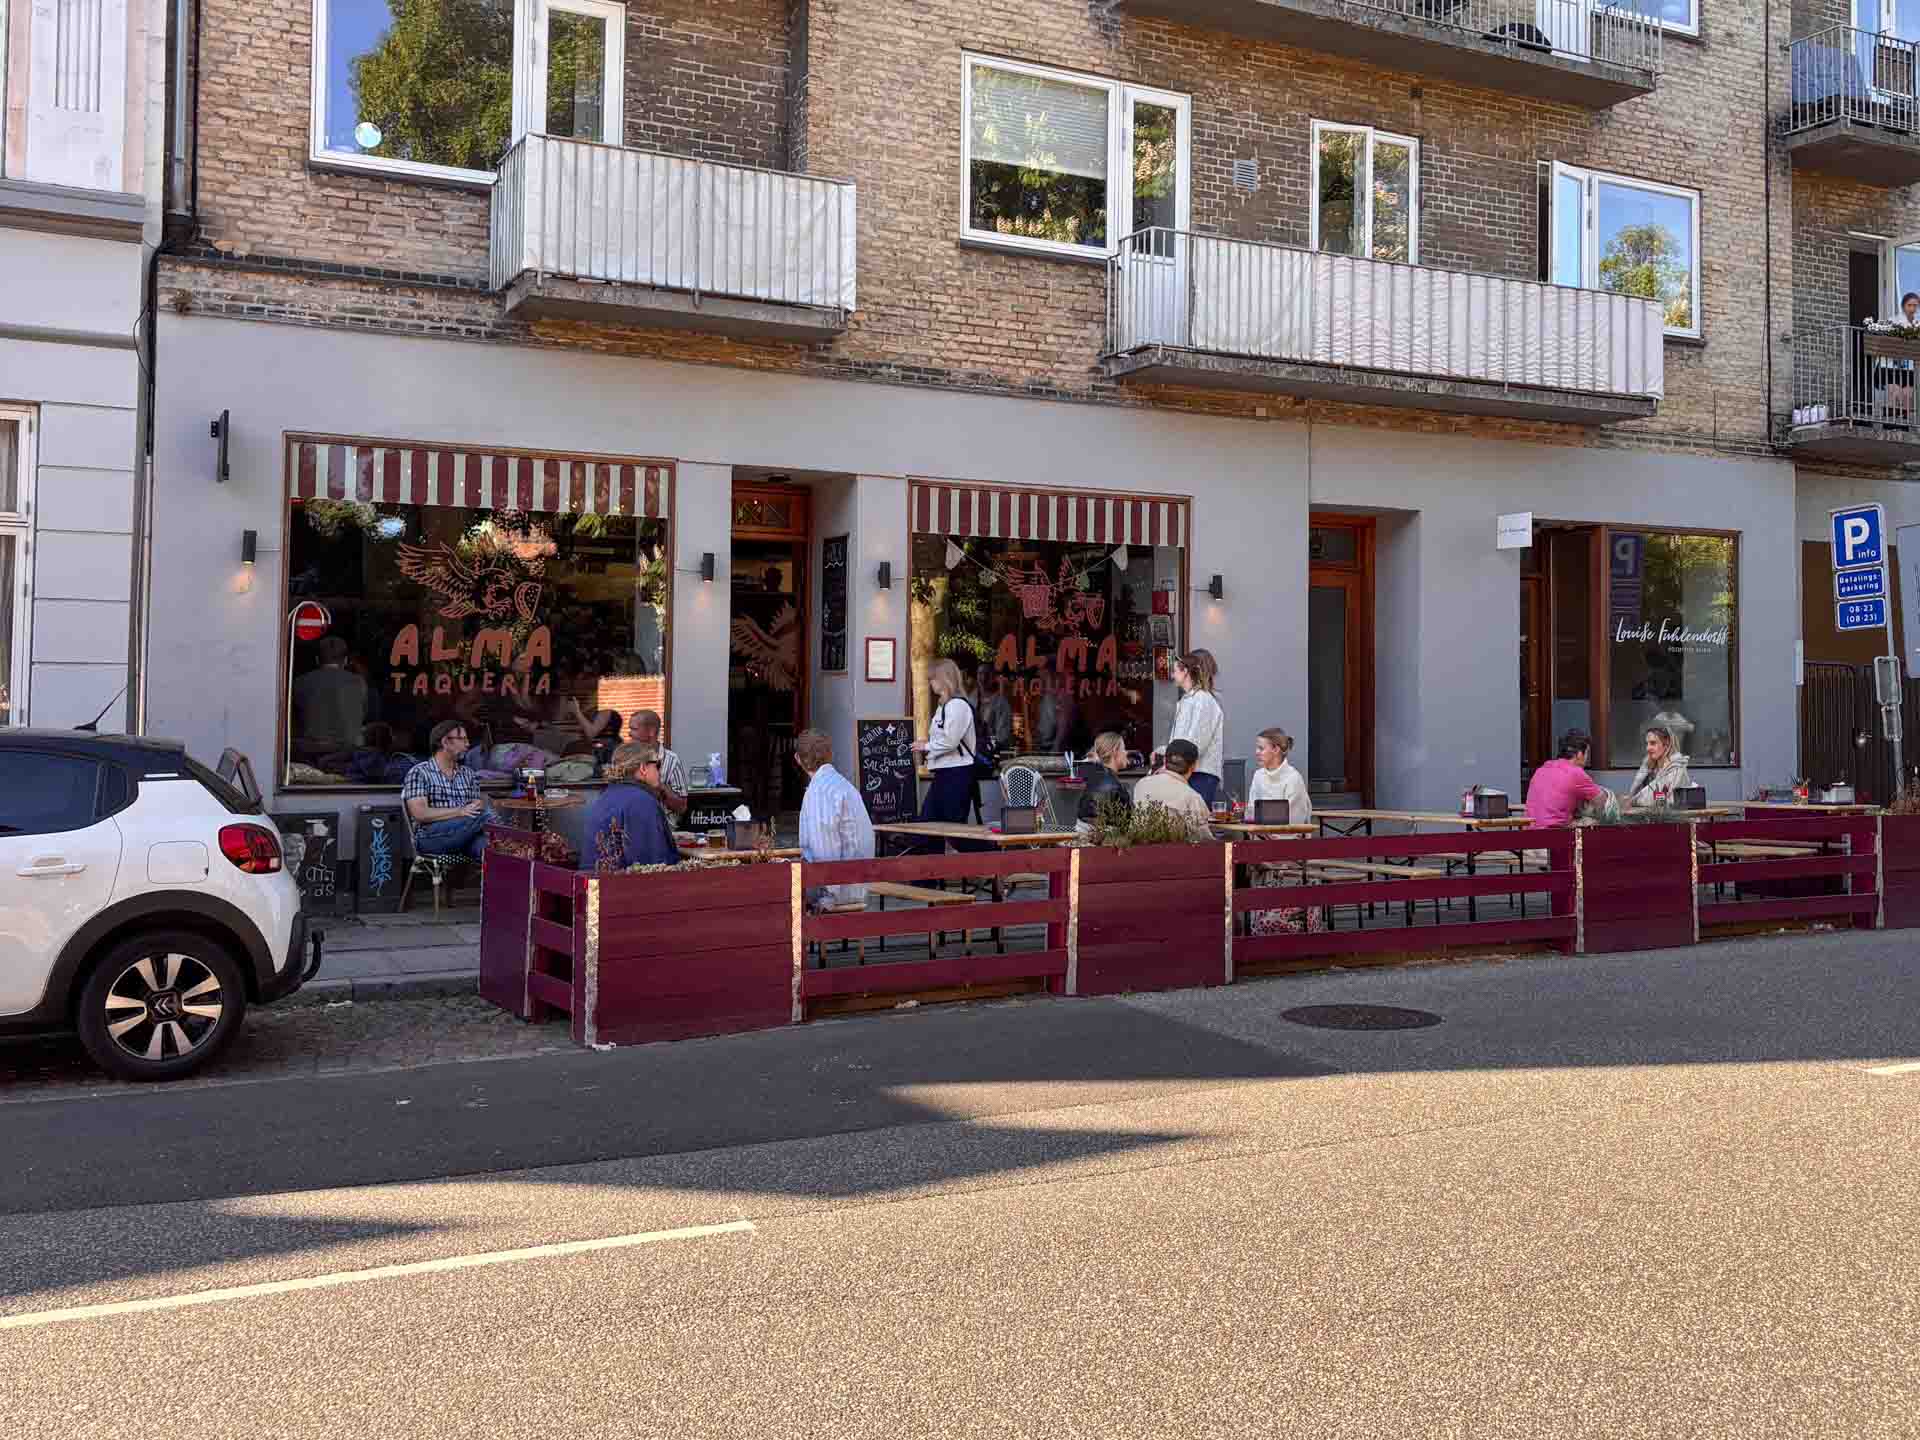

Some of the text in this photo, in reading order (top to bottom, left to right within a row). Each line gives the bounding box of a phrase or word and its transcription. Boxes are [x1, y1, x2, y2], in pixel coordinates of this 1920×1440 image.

[1844, 518, 1870, 561] P
[1858, 549, 1877, 559] info
[390, 623, 552, 670] ALMA
[994, 633, 1118, 673] ALMA
